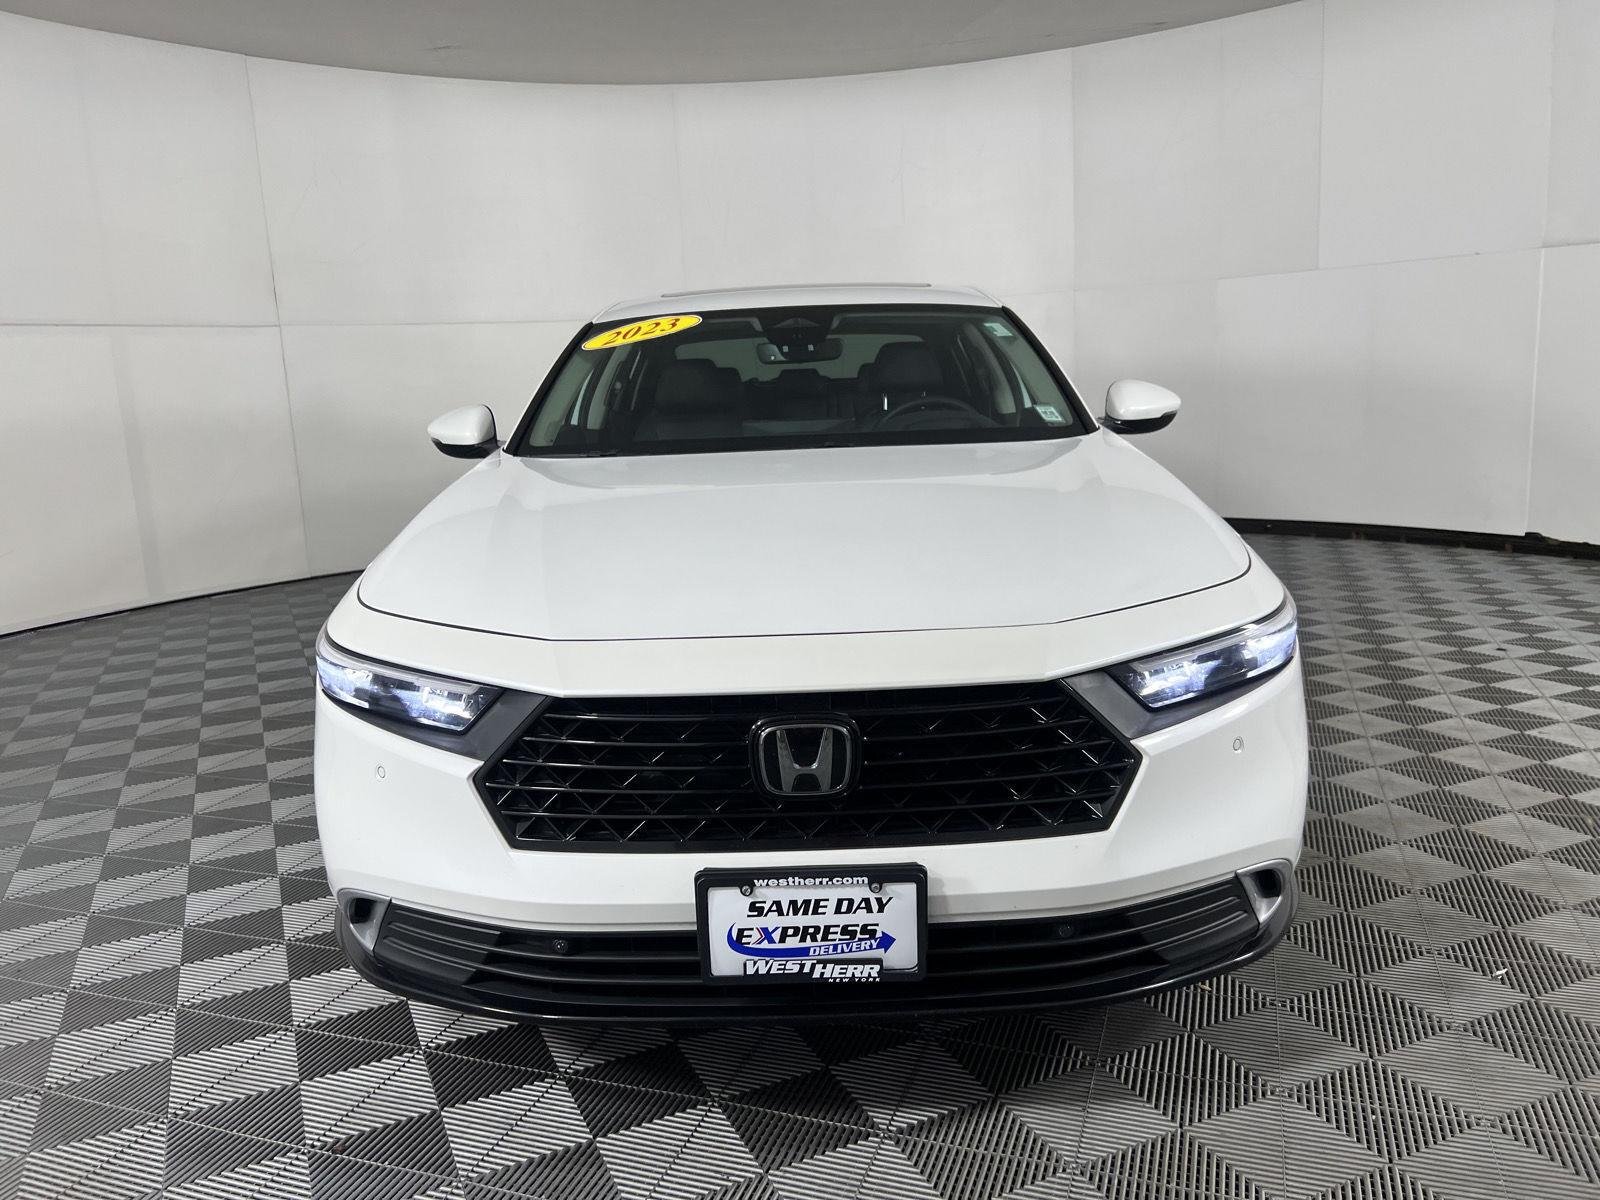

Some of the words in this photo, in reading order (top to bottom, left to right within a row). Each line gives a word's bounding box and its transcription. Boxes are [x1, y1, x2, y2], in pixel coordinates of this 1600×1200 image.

[602, 318, 680, 346] 2023
[753, 876, 869, 887] westherr.com
[747, 898, 828, 917] SAME
[834, 896, 894, 915] DAY
[735, 923, 880, 946] EXPRESS
[809, 938, 881, 956] DELIVERY
